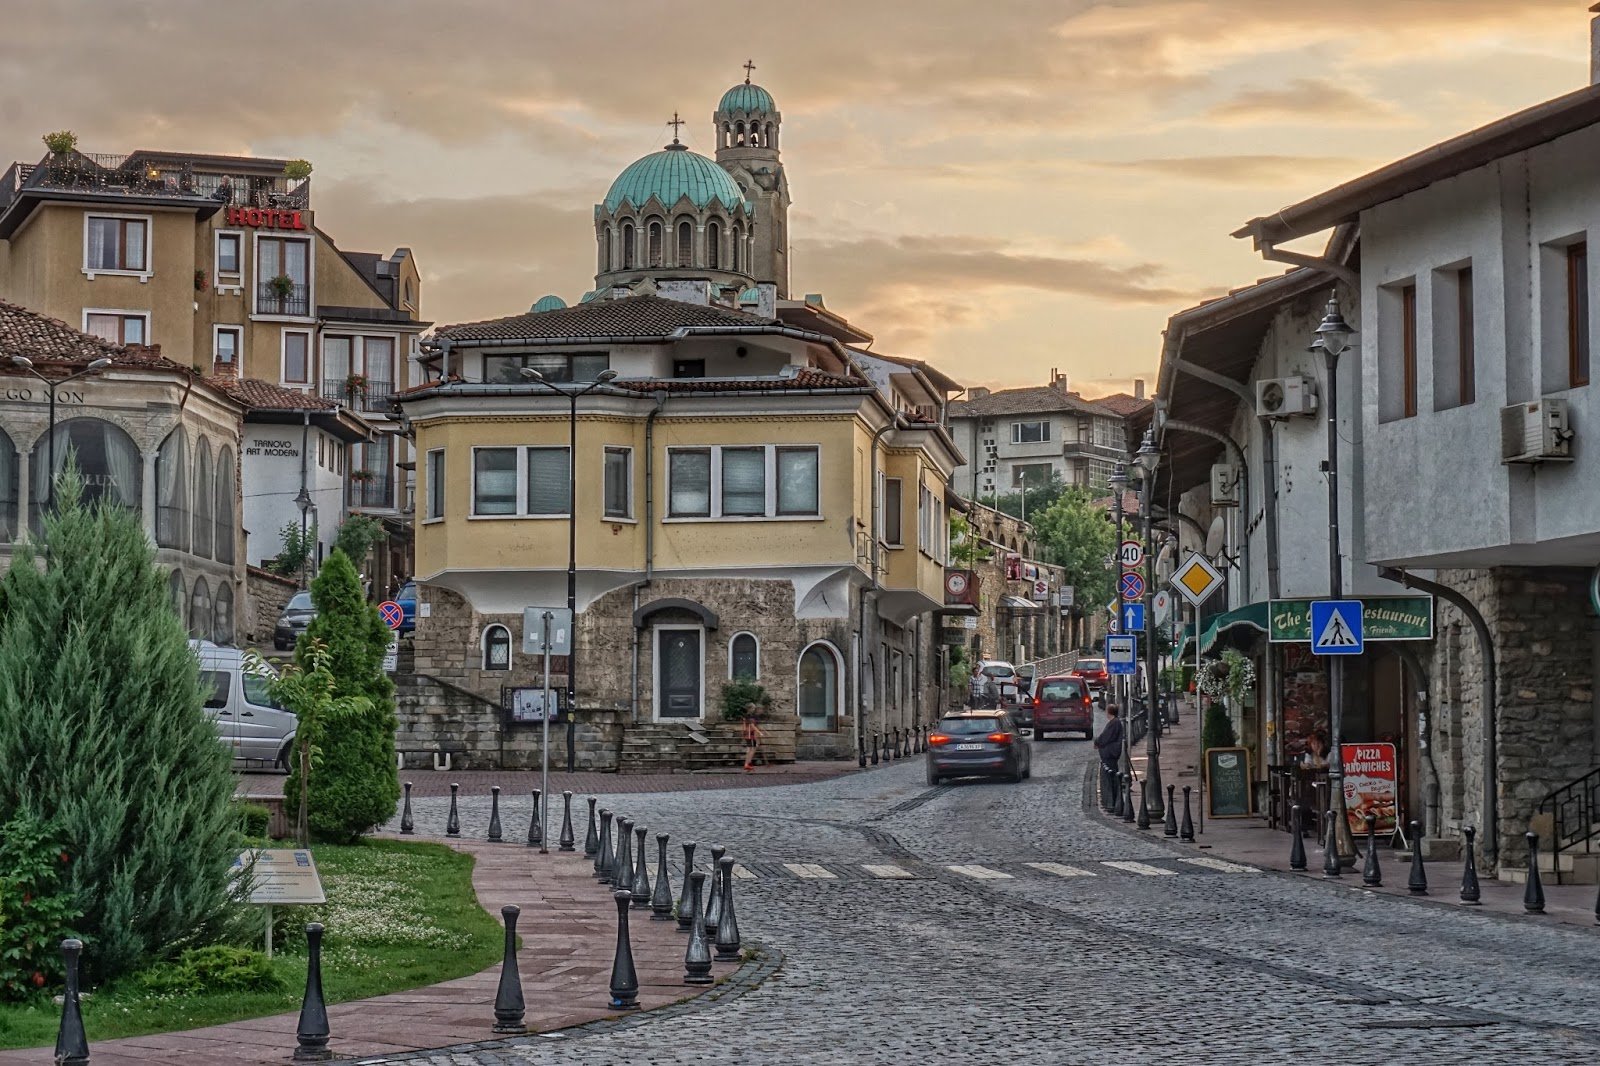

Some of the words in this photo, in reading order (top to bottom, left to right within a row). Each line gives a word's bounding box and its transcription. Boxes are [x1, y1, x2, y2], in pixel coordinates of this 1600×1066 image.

[229, 207, 306, 230] HOTEL
[253, 440, 292, 448] TARNOVO
[264, 449, 299, 457] MODERN
[1122, 547, 1138, 562] 40
[1274, 611, 1301, 630] The
[1363, 607, 1428, 628] estaurant
[1370, 624, 1397, 636] Friends
[1357, 748, 1381, 760] PIZZA
[1343, 761, 1391, 773] ANDWICHES
